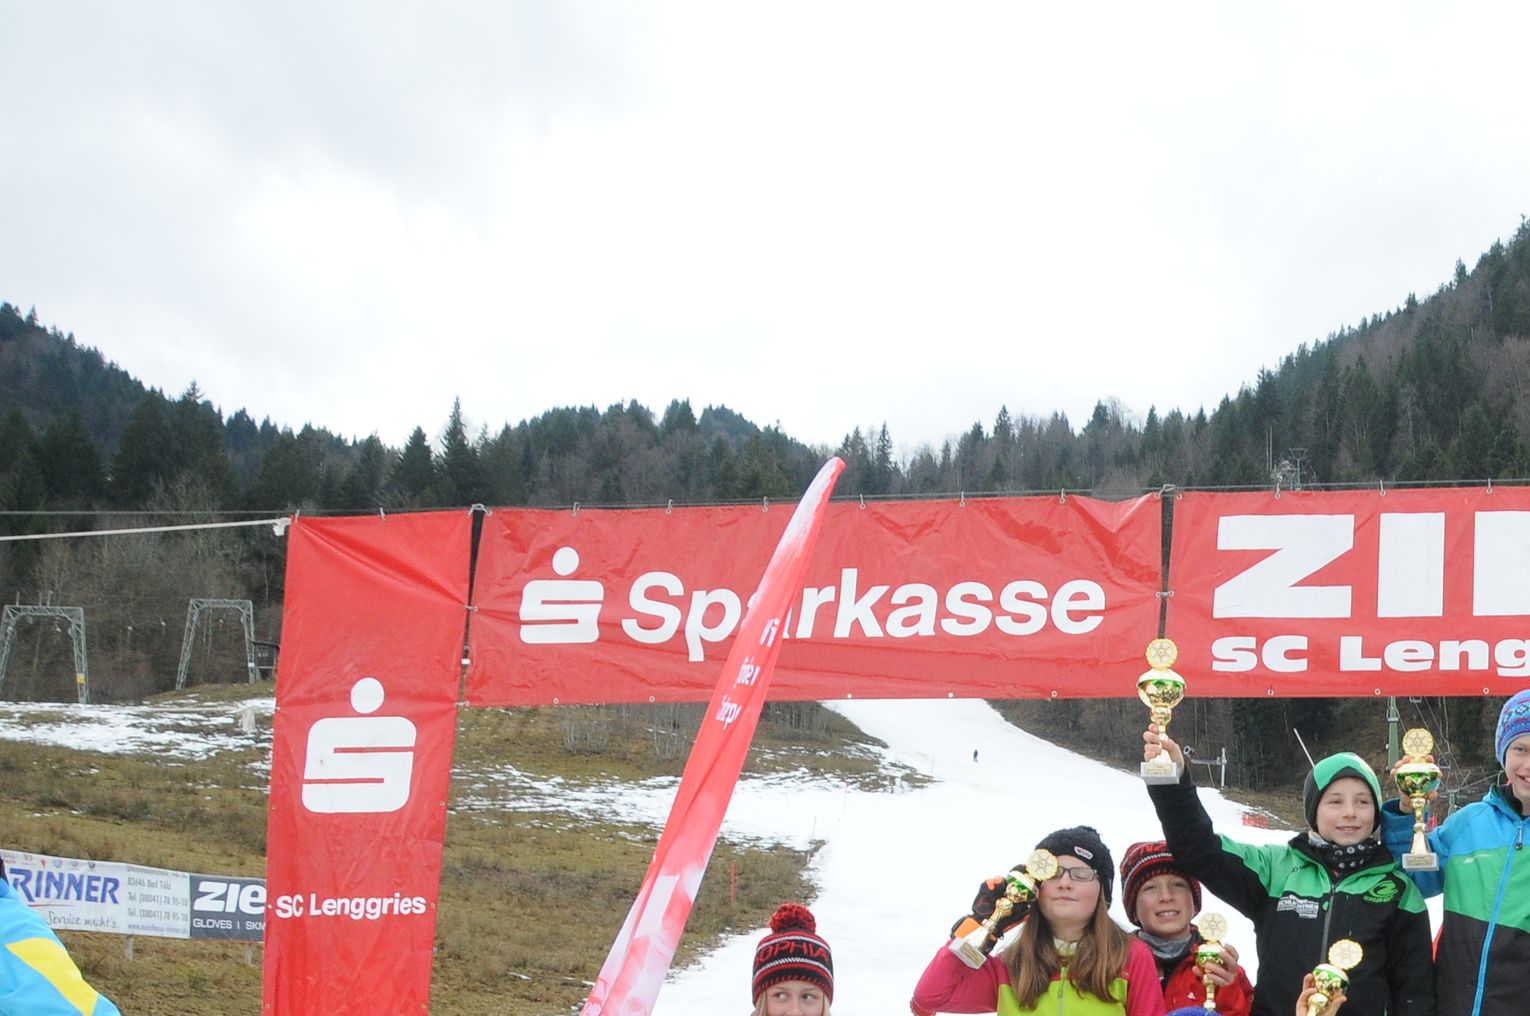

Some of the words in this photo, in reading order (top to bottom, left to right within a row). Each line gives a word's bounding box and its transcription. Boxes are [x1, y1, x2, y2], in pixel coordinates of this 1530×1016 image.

[622, 567, 1105, 662] Sprkasse
[1212, 635, 1308, 673] SC
[9, 867, 120, 904] RINNER
[146, 879, 158, 888] Bad
[275, 893, 303, 919] SC
[309, 892, 427, 921] Lenggries
[192, 918, 233, 929] GLOVES
